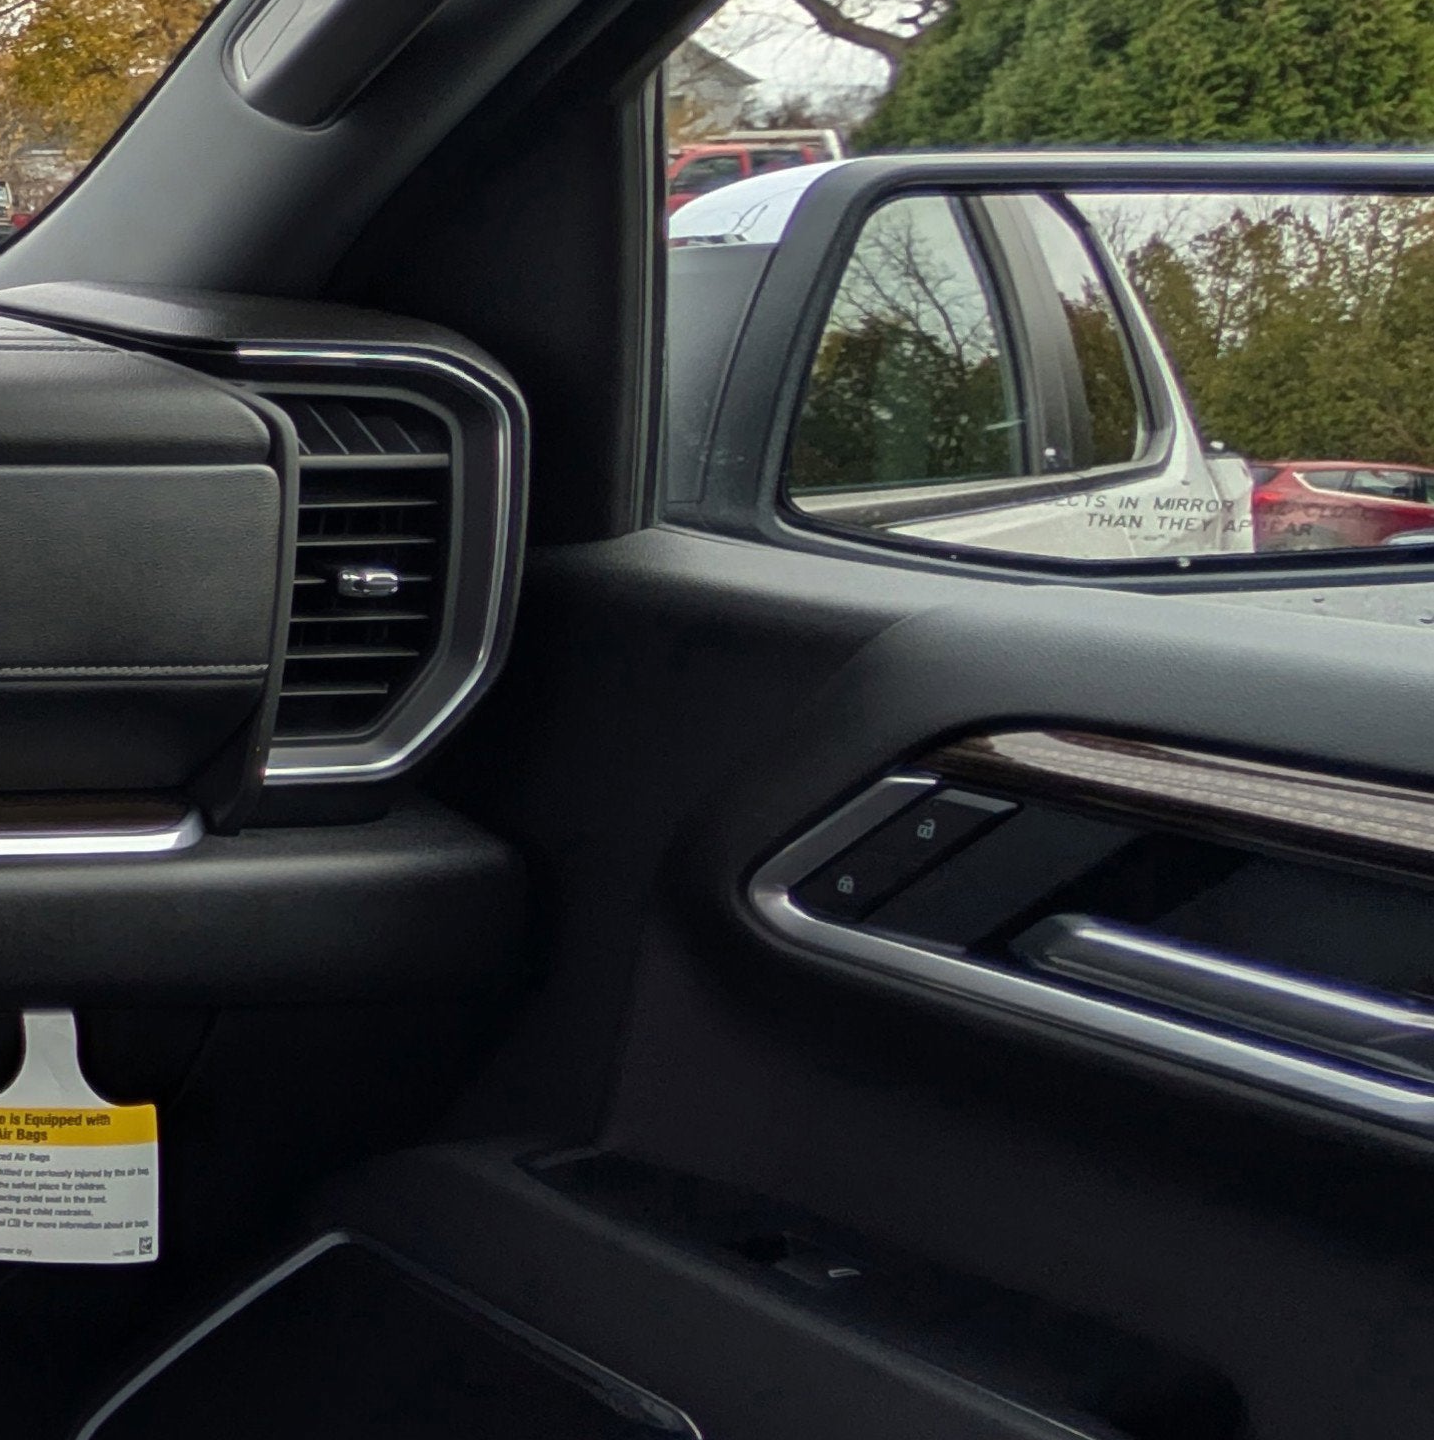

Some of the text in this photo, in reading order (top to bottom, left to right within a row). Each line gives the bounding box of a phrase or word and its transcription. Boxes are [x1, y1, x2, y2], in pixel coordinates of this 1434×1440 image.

[1118, 496, 1139, 509] IN
[1153, 497, 1234, 513] MIRROR
[1087, 513, 1144, 528] THAN
[1157, 515, 1214, 532] THEY
[25, 1113, 82, 1128] Equipped
[86, 1114, 110, 1126] with
[17, 1129, 48, 1143] Bags
[15, 1153, 26, 1161] Air
[29, 1153, 50, 1163] Bags
